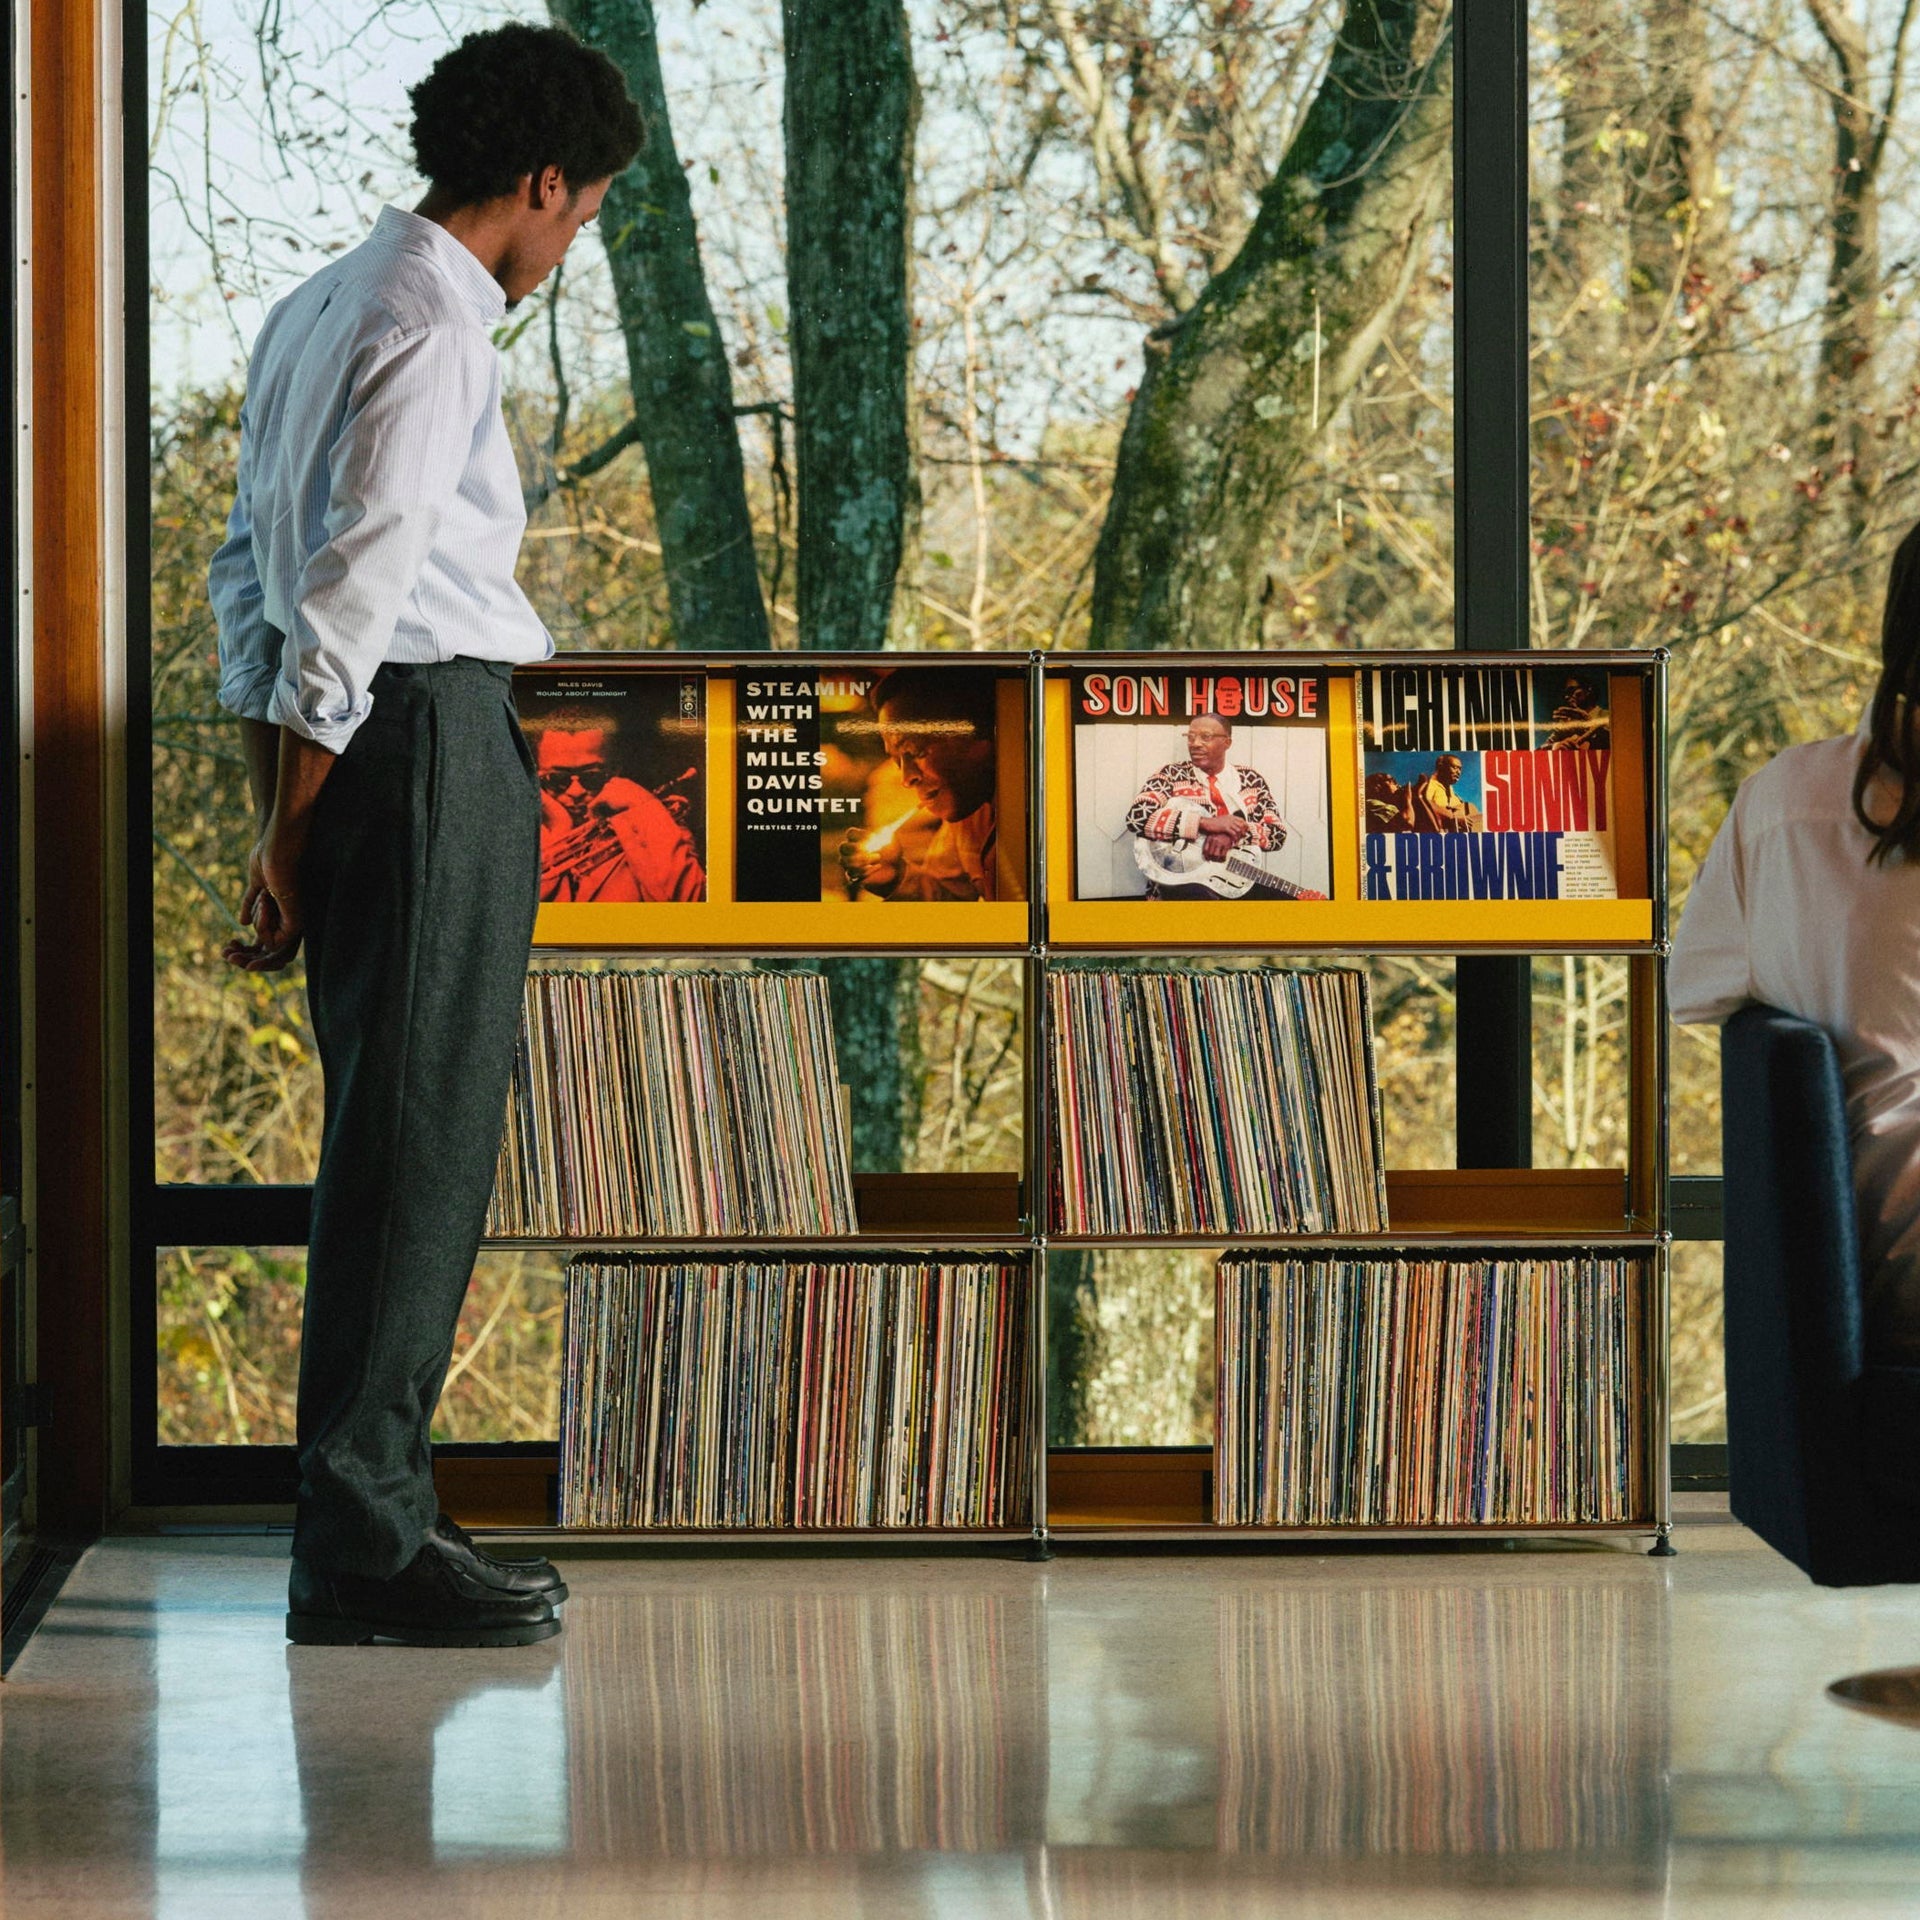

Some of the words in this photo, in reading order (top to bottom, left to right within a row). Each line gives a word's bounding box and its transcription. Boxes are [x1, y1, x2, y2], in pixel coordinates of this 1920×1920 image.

[1082, 674, 1169, 716] SON
[1185, 676, 1317, 718] HOUSE
[746, 705, 813, 720] WITH
[746, 729, 798, 743] THE
[747, 752, 828, 767] MILES
[747, 775, 823, 790] DAVIS
[1485, 750, 1611, 832] SONNY
[747, 798, 861, 815] QUINTET
[1366, 833, 1392, 900] &
